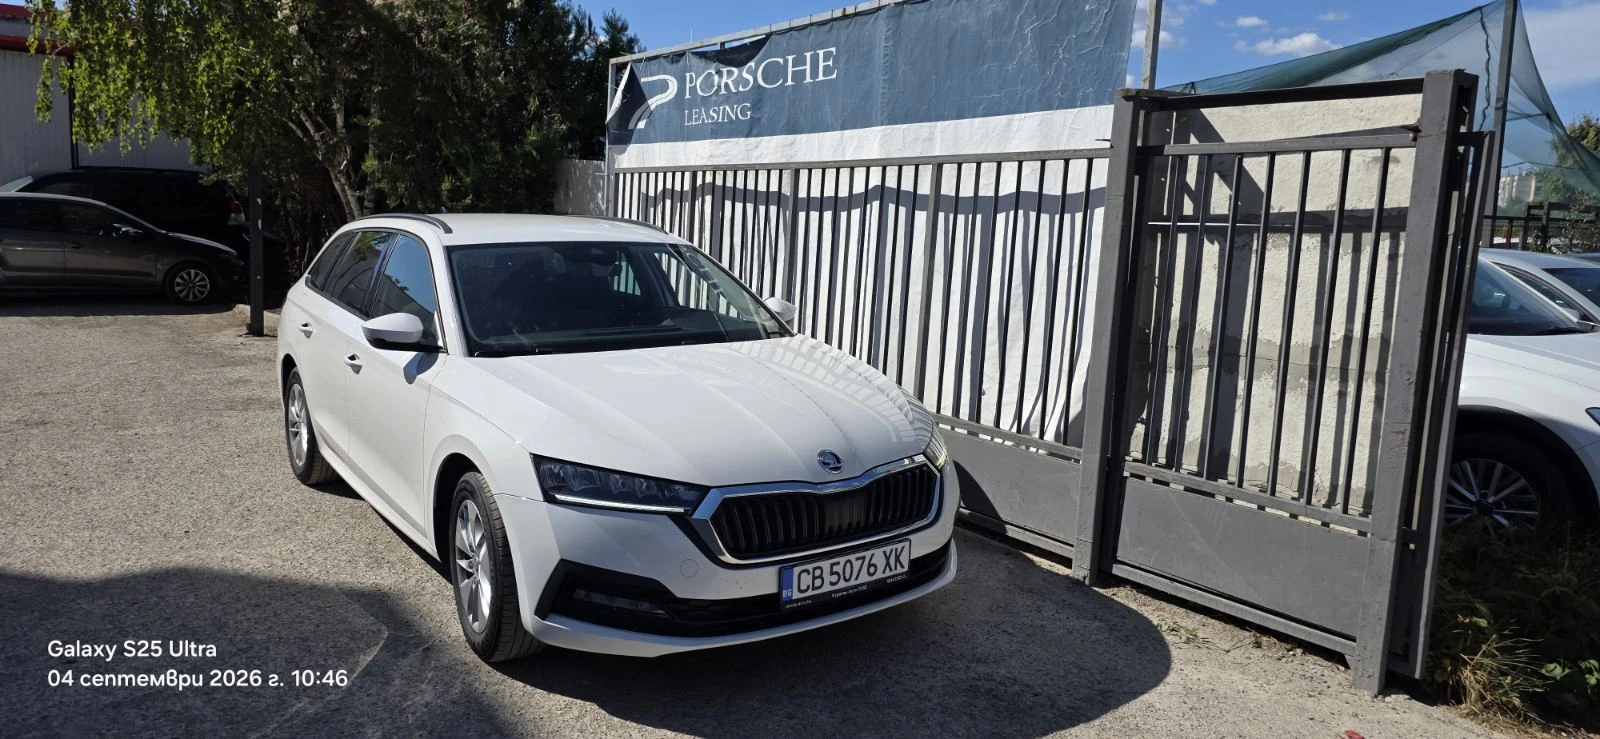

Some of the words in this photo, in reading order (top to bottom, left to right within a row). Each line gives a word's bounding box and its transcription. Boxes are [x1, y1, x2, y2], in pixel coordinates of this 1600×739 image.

[684, 47, 838, 99] PORSCHE
[684, 103, 752, 126] LEASING
[797, 565, 825, 594] CB
[829, 552, 878, 587] 5076
[882, 545, 906, 575] XK
[782, 588, 793, 598] BG
